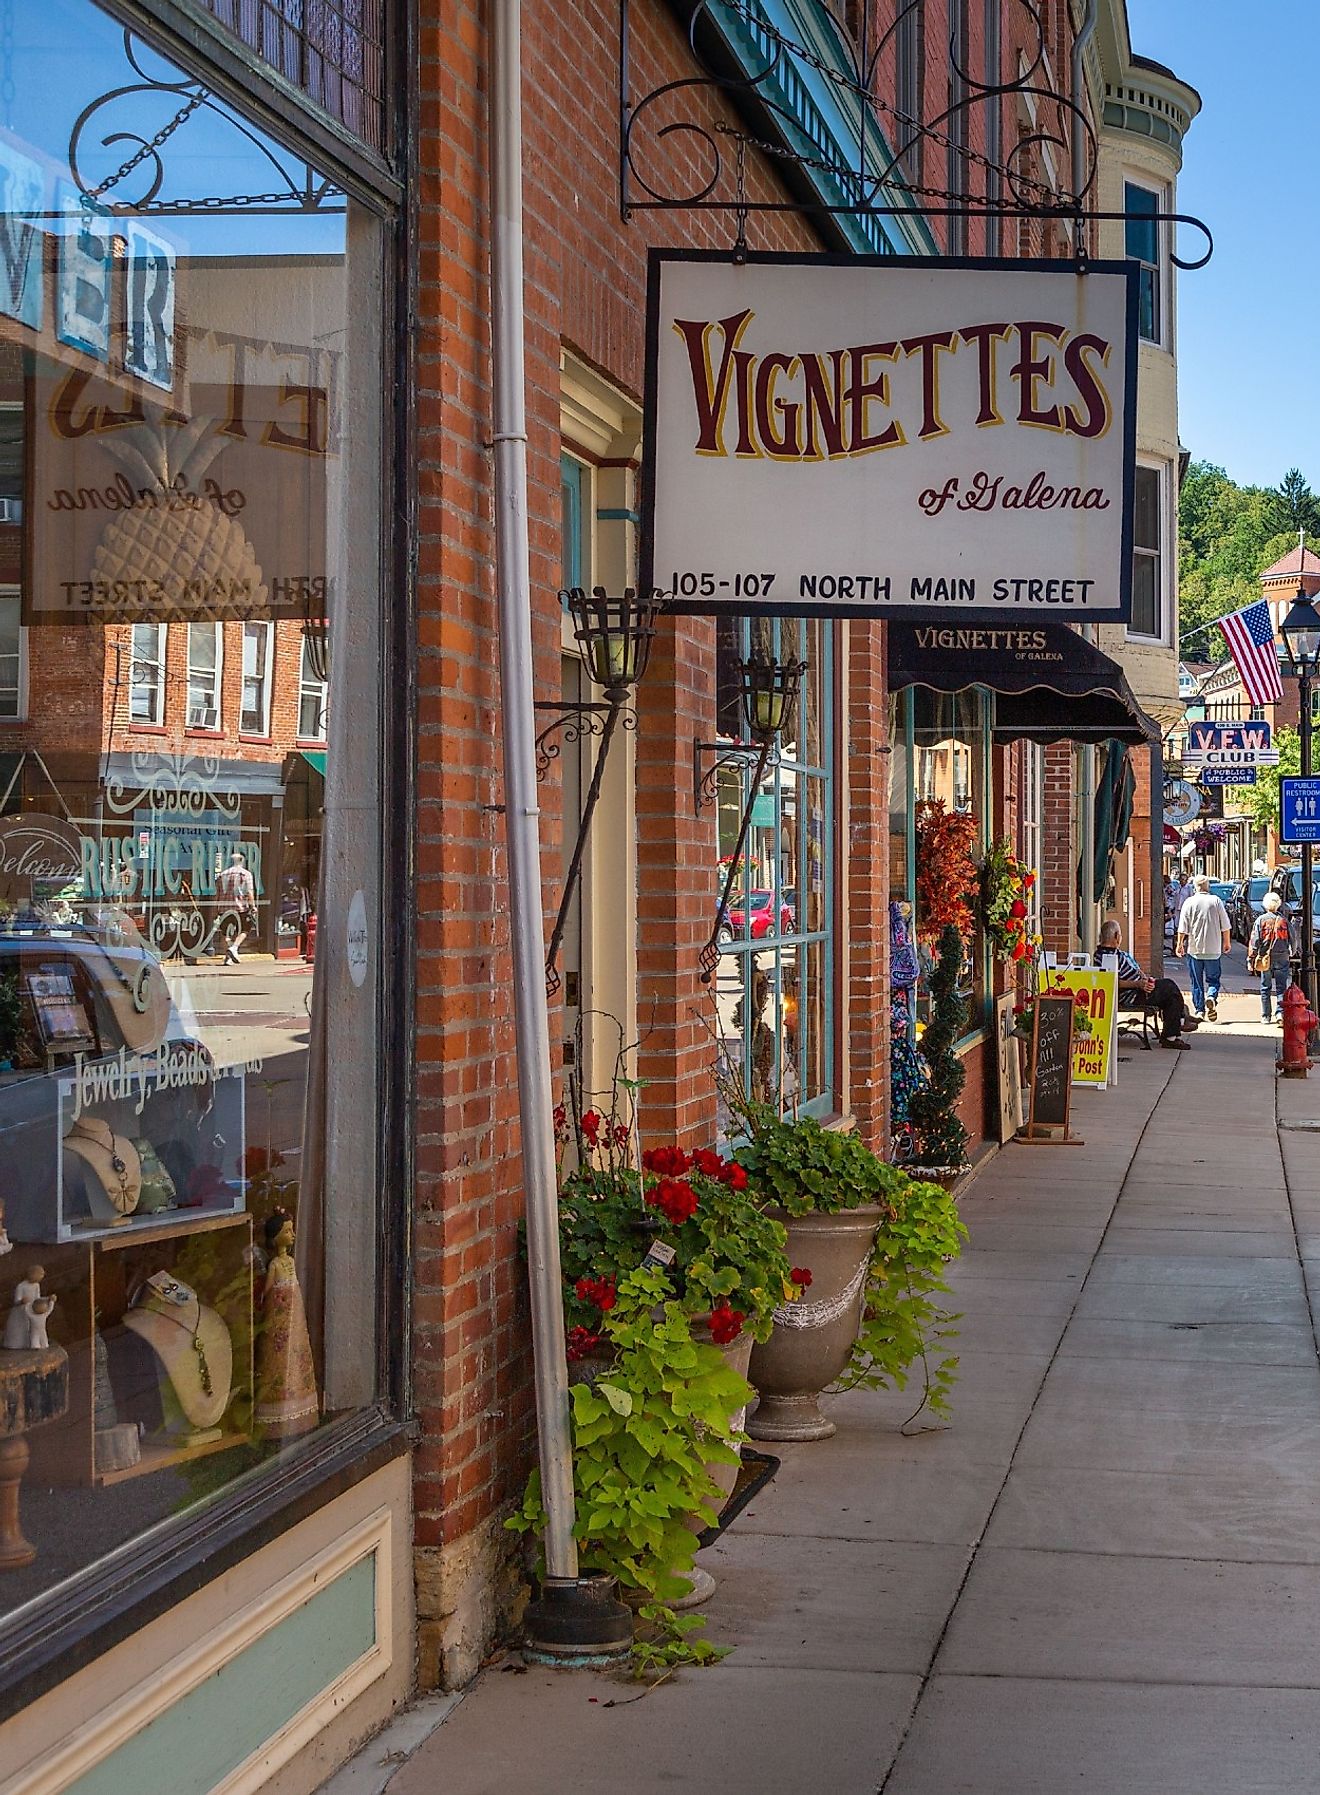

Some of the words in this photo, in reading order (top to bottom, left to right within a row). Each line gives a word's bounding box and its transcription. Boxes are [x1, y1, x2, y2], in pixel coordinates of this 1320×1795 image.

[673, 309, 1113, 463] VIGNETTES
[918, 472, 957, 517] of
[956, 472, 1110, 513] Galena
[673, 572, 776, 598] 105-107
[799, 574, 892, 601] NORTH
[910, 576, 976, 602] MAIN
[992, 579, 1096, 604] STREET
[914, 626, 1048, 650] VIGNETTES
[1015, 652, 1027, 660] OF
[1028, 652, 1063, 661] GALENA
[1206, 752, 1255, 762] CLUB
[80, 836, 183, 897] RUSTIC
[190, 840, 265, 897] RIVER
[156, 1041, 208, 1092] Beads
[1078, 1057, 1104, 1075] Post
